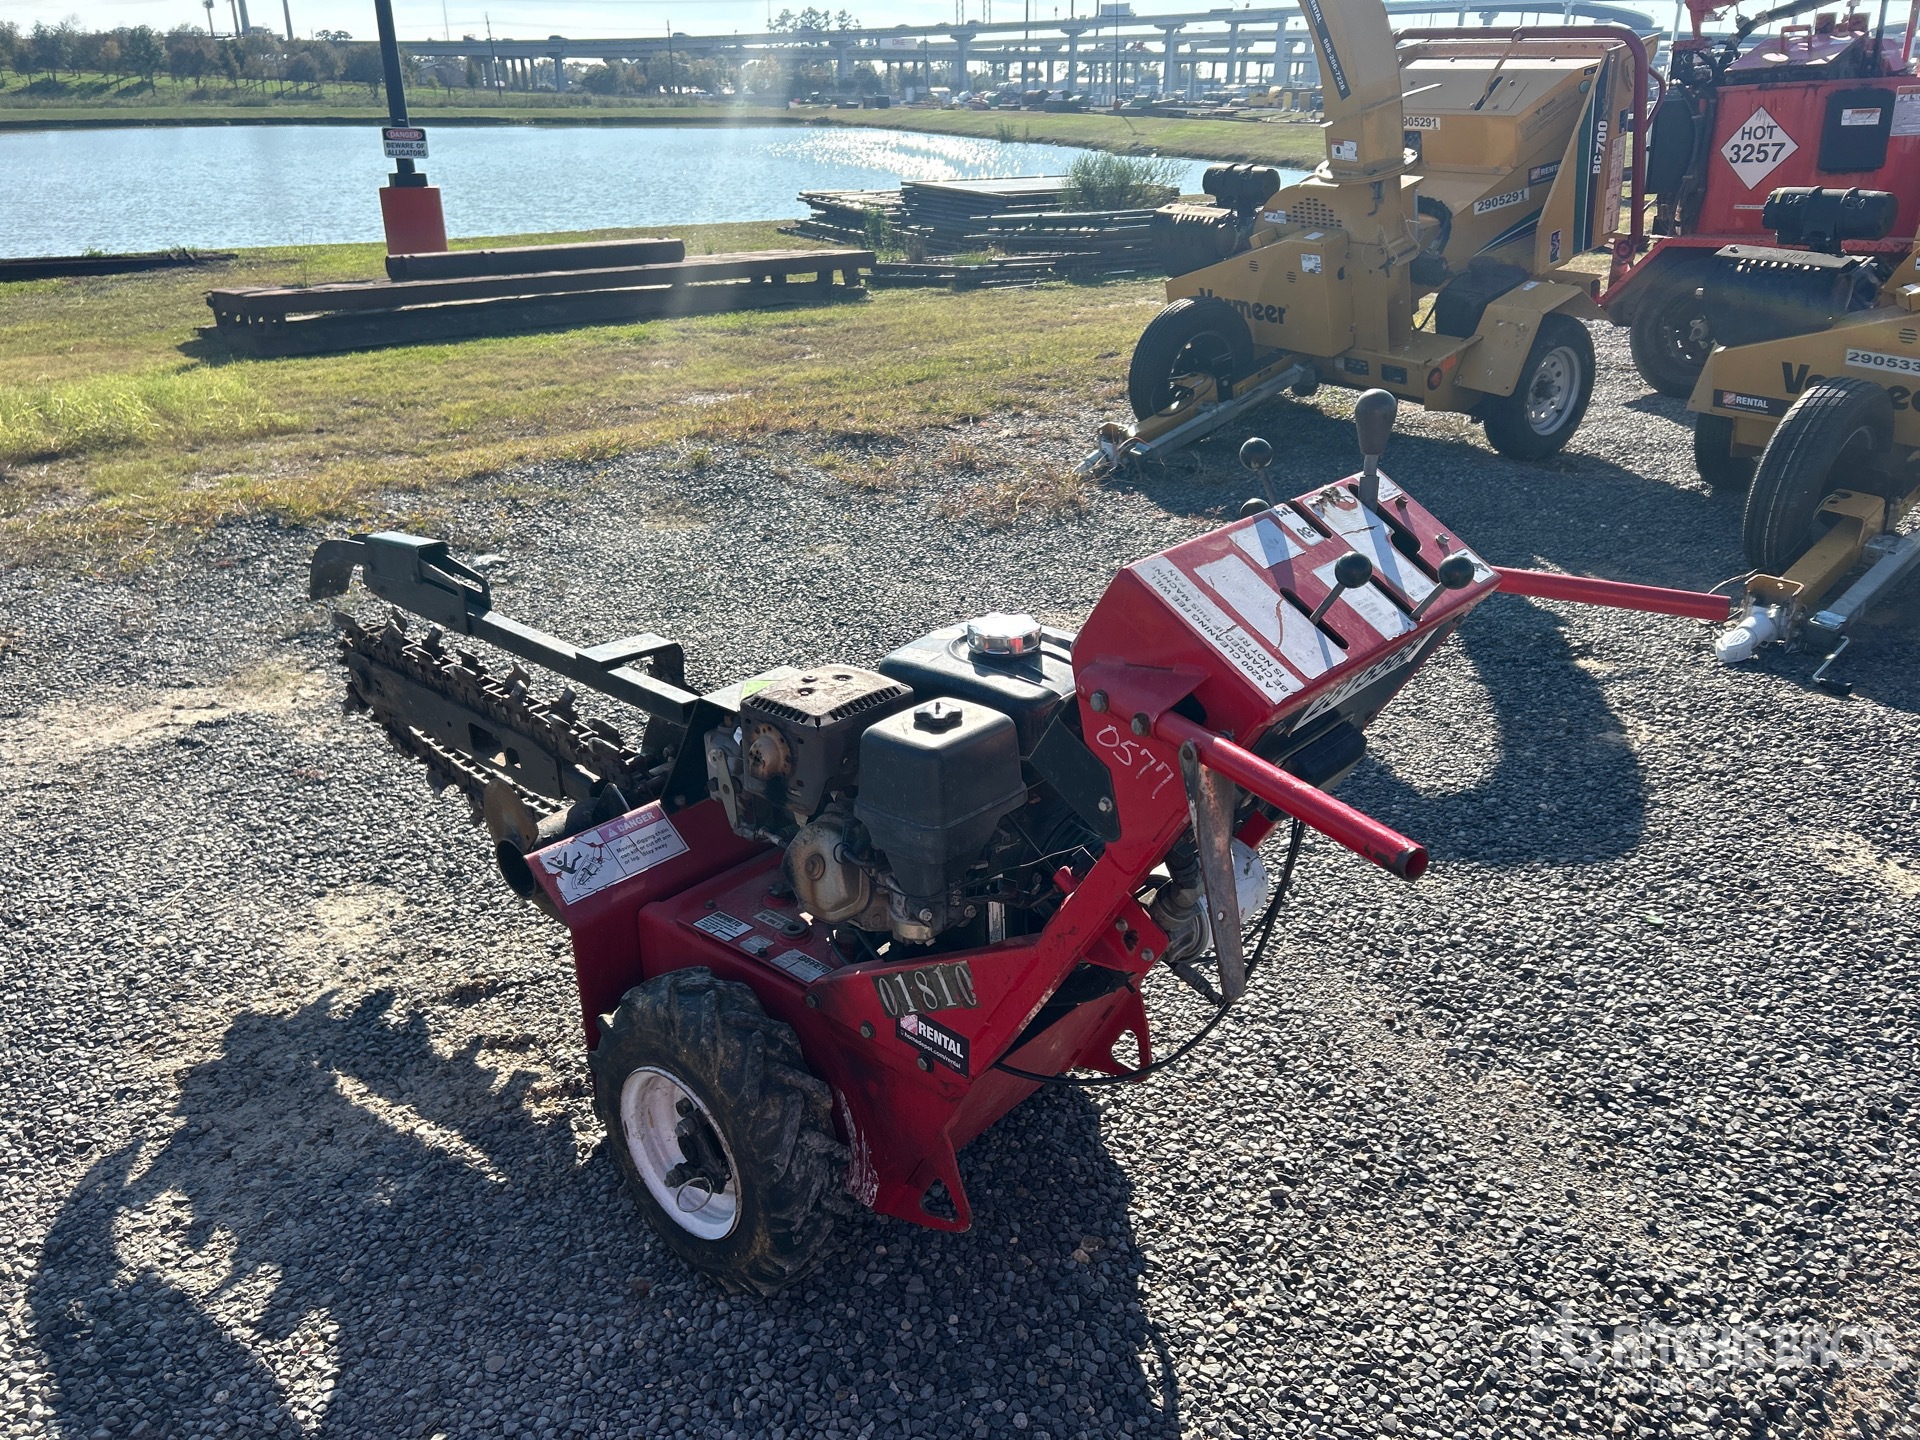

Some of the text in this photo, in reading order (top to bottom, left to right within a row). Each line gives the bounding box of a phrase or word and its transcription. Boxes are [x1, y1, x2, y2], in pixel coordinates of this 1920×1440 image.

[1310, 0, 1322, 24] ENTAL
[1403, 116, 1437, 128] 905291
[390, 131, 419, 139] DANGER
[1741, 125, 1778, 141] HOT
[1592, 121, 1608, 174] BC700
[1729, 143, 1786, 164] 3257
[1541, 164, 1560, 175] RENT
[1477, 189, 1526, 212] 2905291
[1848, 352, 1920, 372] 290533
[1736, 396, 1769, 409] RENTAL
[1151, 574, 1172, 595] WILL
[1171, 594, 1194, 614] FEE
[1190, 602, 1213, 624] THIS
[1190, 613, 1242, 660] CLEANING
[1223, 633, 1274, 679] CHARGED
[1250, 645, 1286, 679] IS NOT
[1240, 659, 1265, 682] $200
[1265, 681, 1274, 689] A
[1273, 679, 1290, 693] BE
[1096, 724, 1175, 800] 0577
[617, 812, 655, 832] DANGER
[616, 843, 636, 853] Moving
[637, 835, 655, 845] digging
[798, 954, 832, 973] BARRETO
[878, 965, 977, 1016] 01810
[918, 1020, 964, 1059] RENTAL
